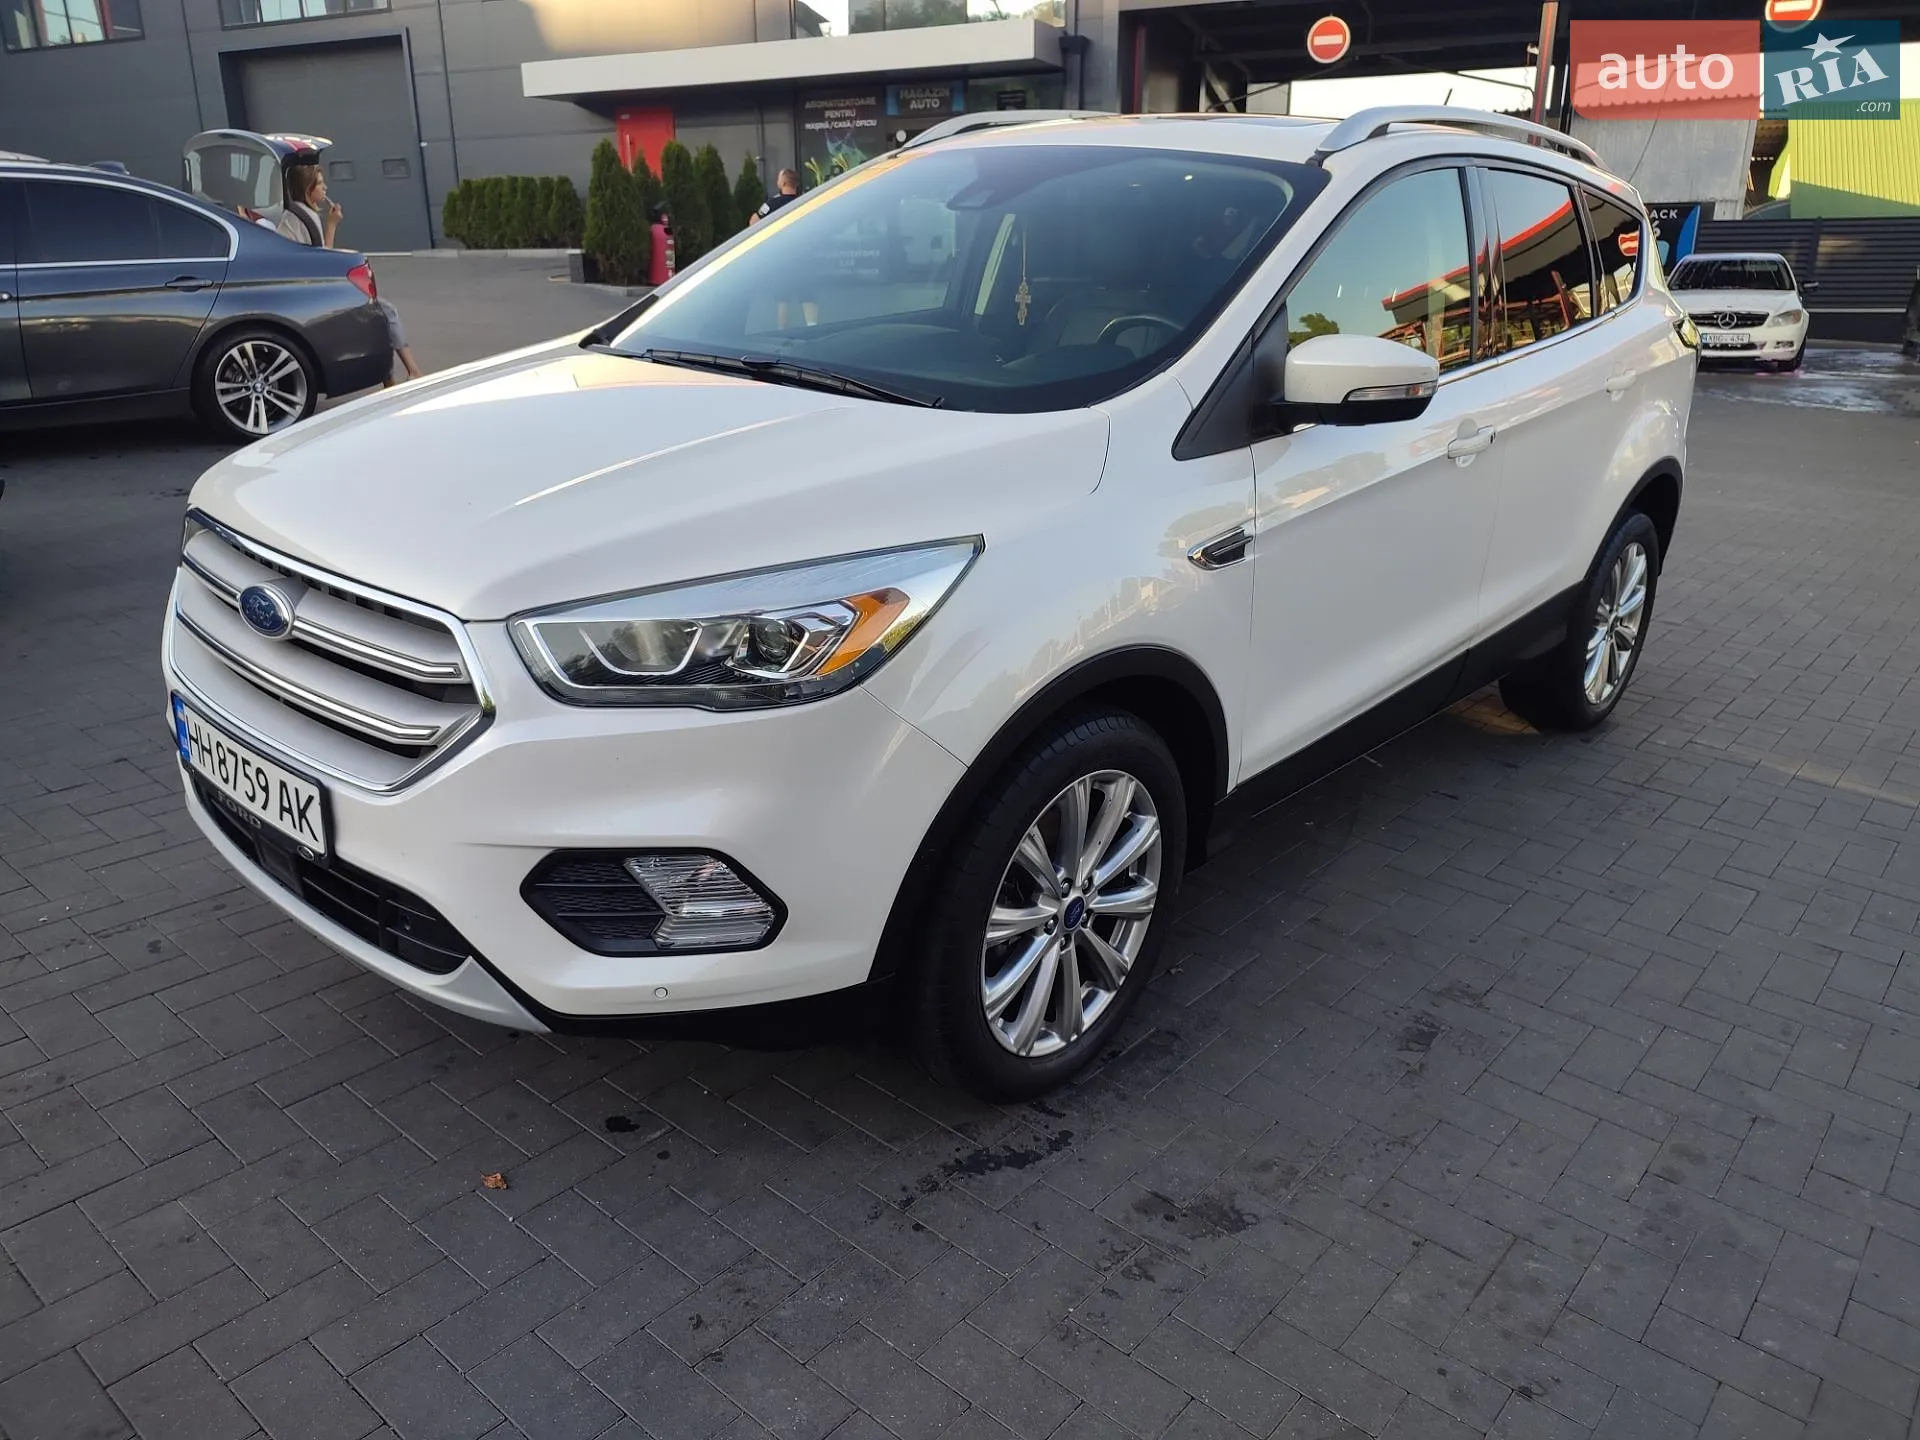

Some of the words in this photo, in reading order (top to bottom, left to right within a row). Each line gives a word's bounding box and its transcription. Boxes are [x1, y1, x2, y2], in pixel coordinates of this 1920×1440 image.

[900, 87, 949, 99] MAGAZIN
[909, 98, 940, 110] AUTO
[825, 110, 856, 118] PENTRU
[216, 740, 270, 811] 8759
[279, 778, 320, 843] AK
